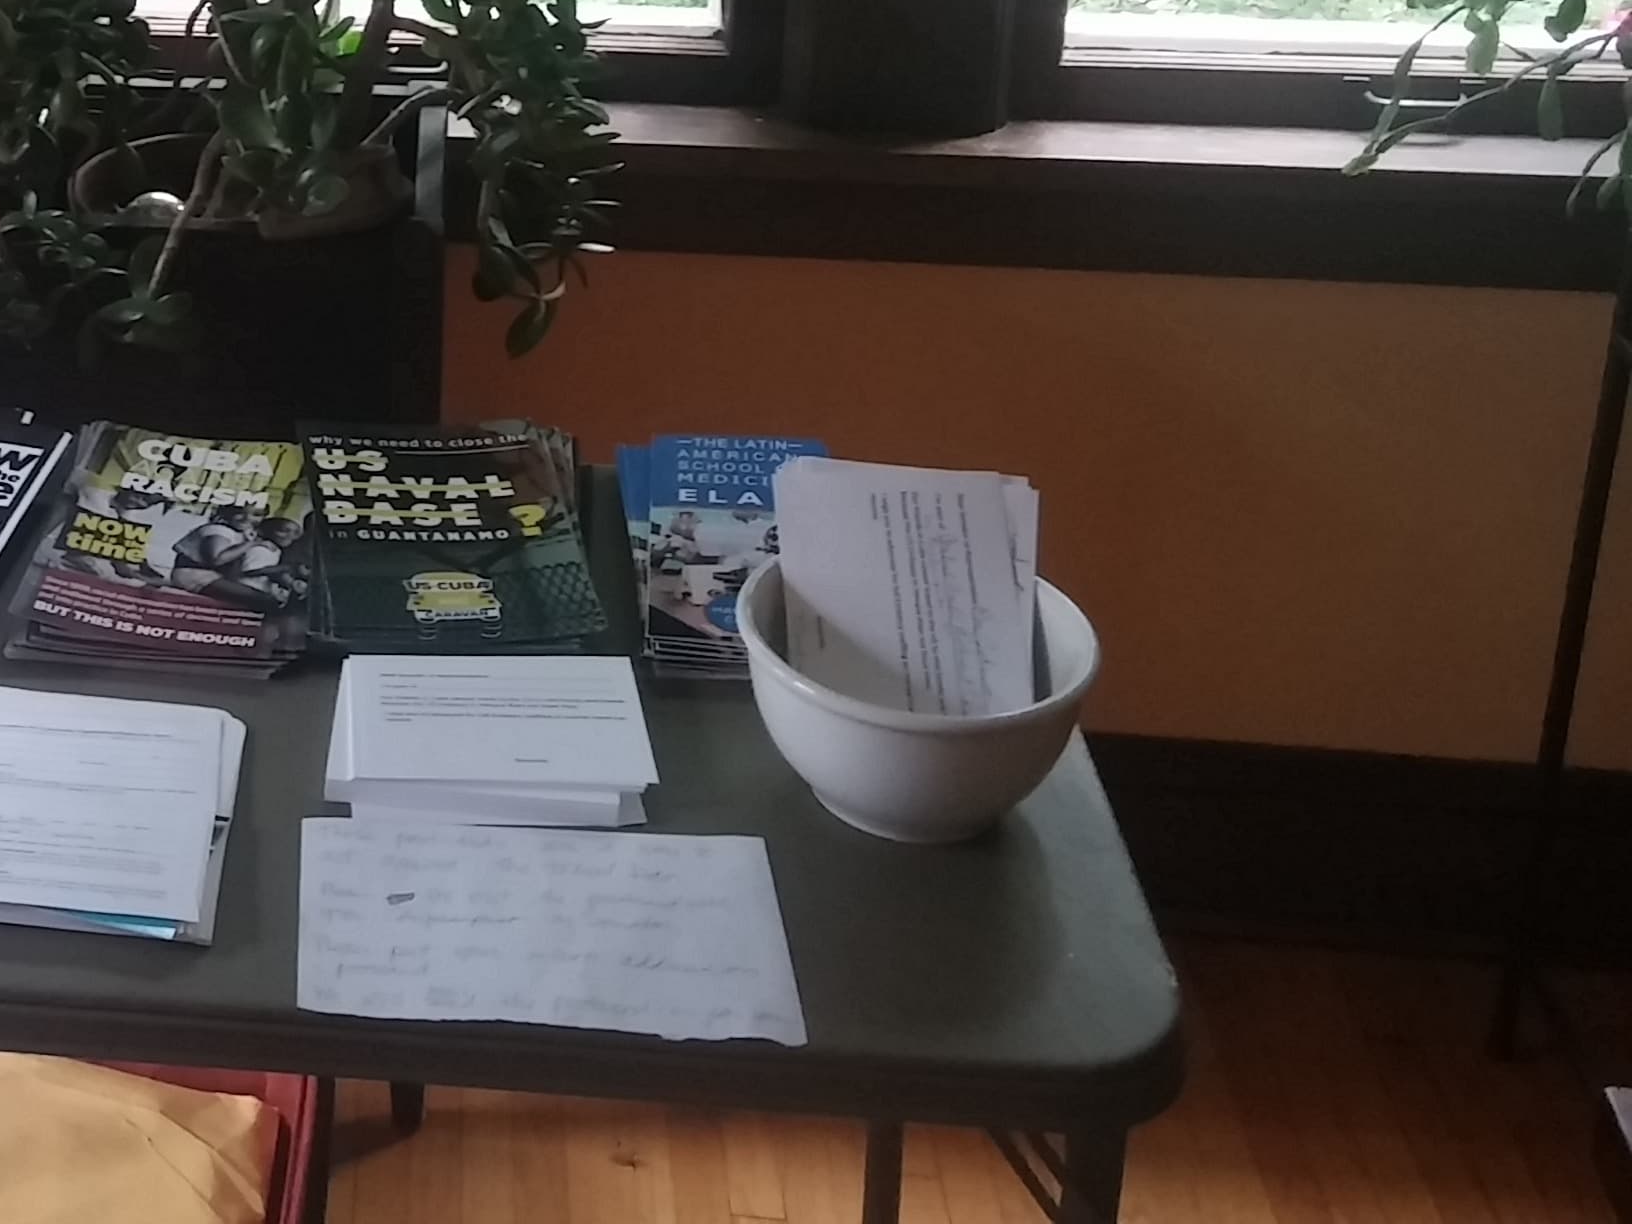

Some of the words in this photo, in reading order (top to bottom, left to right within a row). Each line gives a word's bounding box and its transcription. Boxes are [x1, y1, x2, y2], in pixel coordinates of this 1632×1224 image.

[308, 434, 343, 447] why
[348, 437, 372, 447] we
[377, 436, 420, 449] need
[424, 438, 443, 449] to
[447, 436, 494, 449] close
[498, 433, 529, 445] the
[694, 438, 729, 449] THE
[734, 439, 788, 451] LATIN
[138, 439, 273, 477] CUBA
[314, 447, 388, 472] US
[677, 461, 766, 475] SCHOOL
[120, 471, 269, 509] RACISM
[318, 473, 516, 500] NAVAL
[677, 473, 768, 487] MEDICI
[72, 511, 152, 543] NOW
[323, 500, 483, 527] BASE
[65, 530, 146, 564] time
[328, 529, 349, 540] in
[356, 528, 510, 542] GUANTANAMO
[33, 600, 72, 617] BUT
[73, 608, 113, 628] THIS
[115, 621, 135, 633] IS
[136, 624, 176, 639] NOT
[177, 630, 256, 648] ENOUGH
